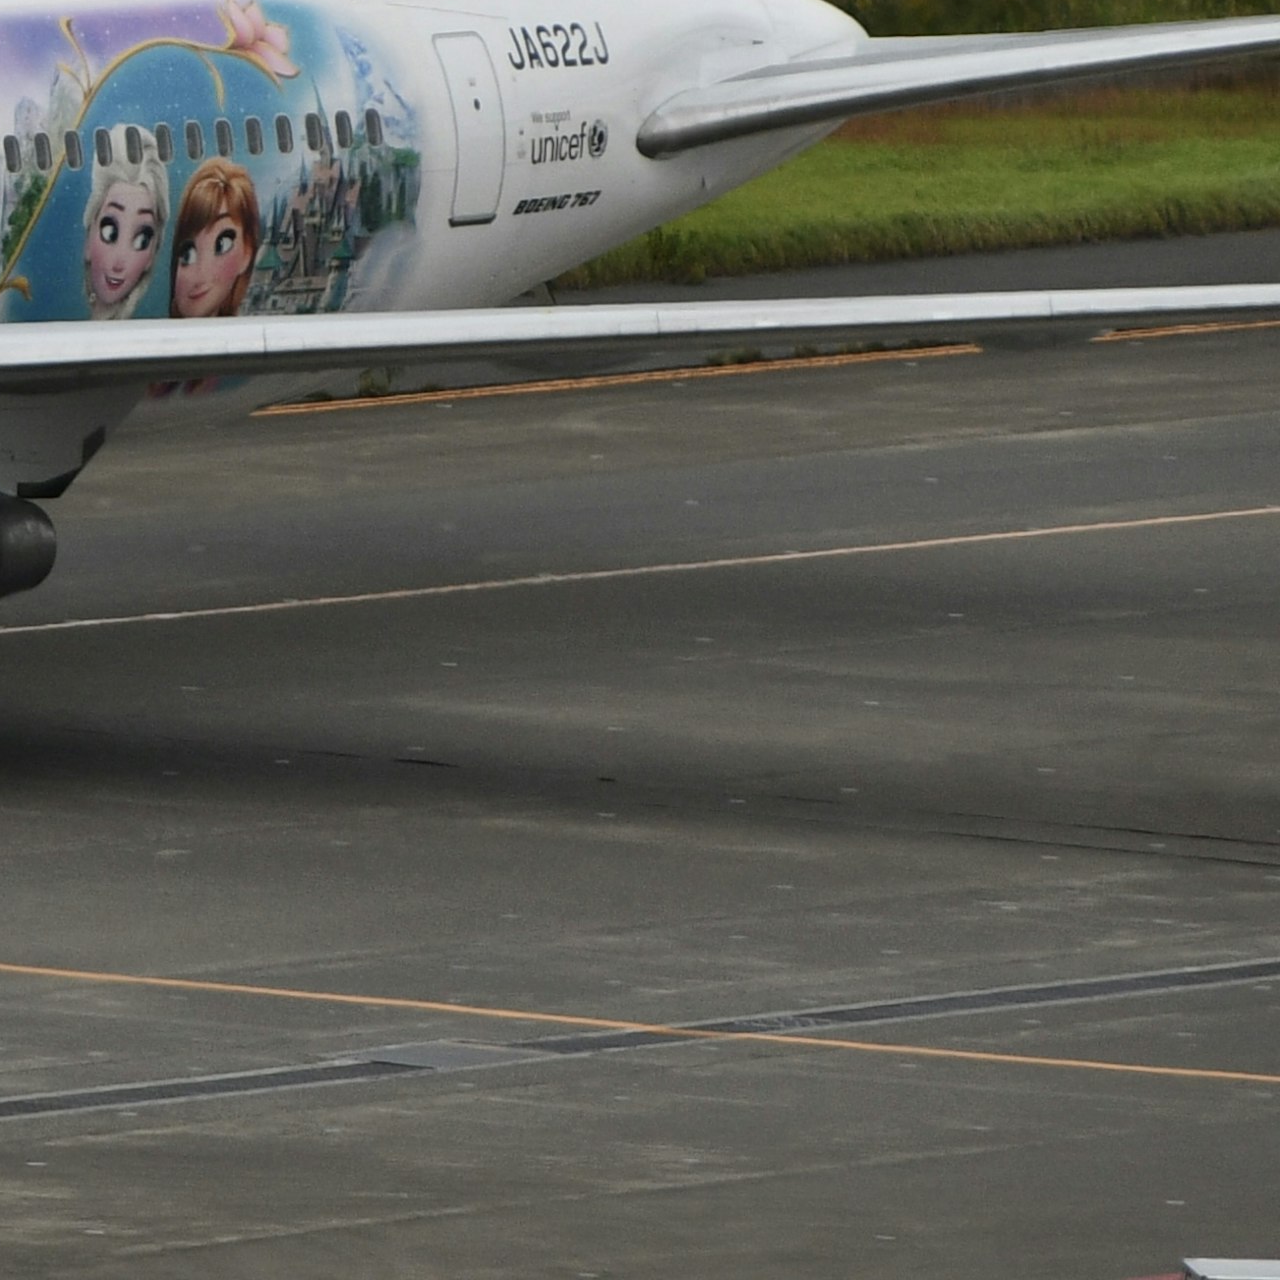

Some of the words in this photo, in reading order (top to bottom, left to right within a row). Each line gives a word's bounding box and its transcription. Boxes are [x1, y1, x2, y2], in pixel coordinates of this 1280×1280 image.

[507, 21, 610, 70] JA622J
[531, 121, 587, 164] unicef
[513, 194, 571, 215] BOEING
[570, 190, 602, 208] 767
